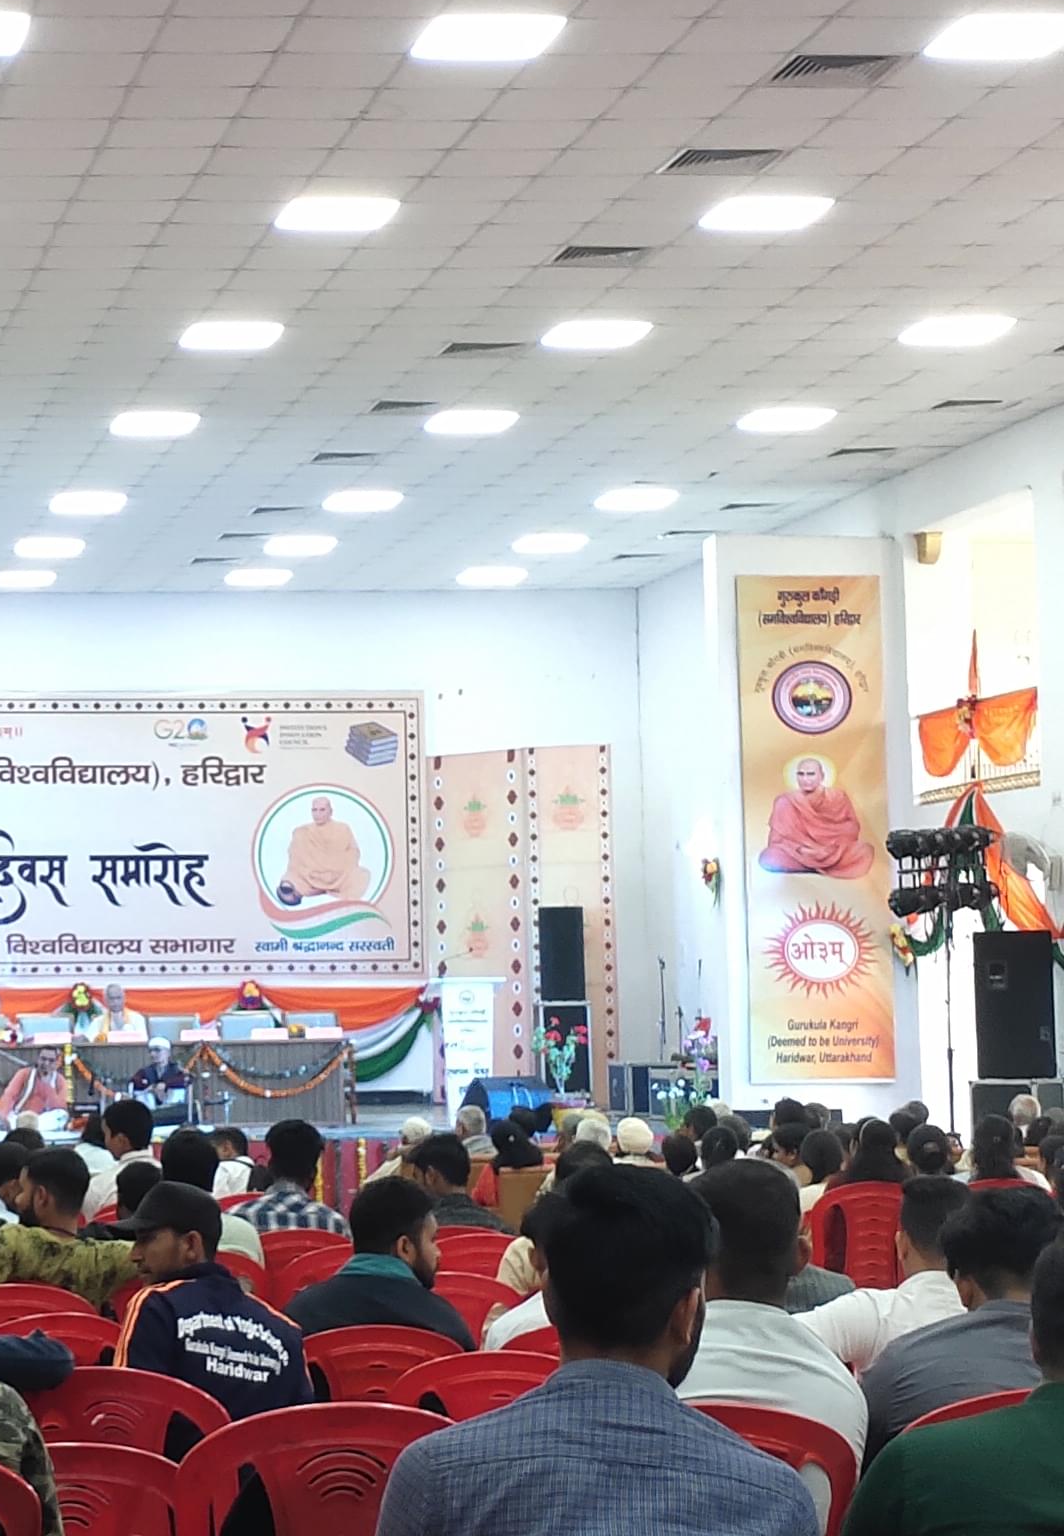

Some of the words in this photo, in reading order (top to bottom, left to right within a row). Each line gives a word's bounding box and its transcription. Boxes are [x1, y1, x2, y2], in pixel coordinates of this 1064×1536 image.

[777, 590, 810, 607] गुरुकुल
[834, 609, 861, 626] हरिद्वार
[181, 756, 267, 787] हरिद्वार
[89, 842, 215, 908] समारोह
[6, 933, 141, 956] विश्वविद्यालय
[149, 937, 236, 955] सभागार
[255, 937, 288, 952] स्वामी
[349, 936, 395, 952] सरस्वती
[791, 933, 851, 968] ओ३म्
[787, 1019, 827, 1031] Gurukula
[830, 1018, 858, 1032] Kangri
[768, 1036, 805, 1049] (Deemed
[808, 1037, 817, 1046] to
[820, 1036, 830, 1046] be
[833, 1036, 879, 1049] University)
[776, 1053, 816, 1064] Haridwar,
[819, 1052, 872, 1064] Uttarakhand
[206, 1356, 270, 1382] Haridwar
